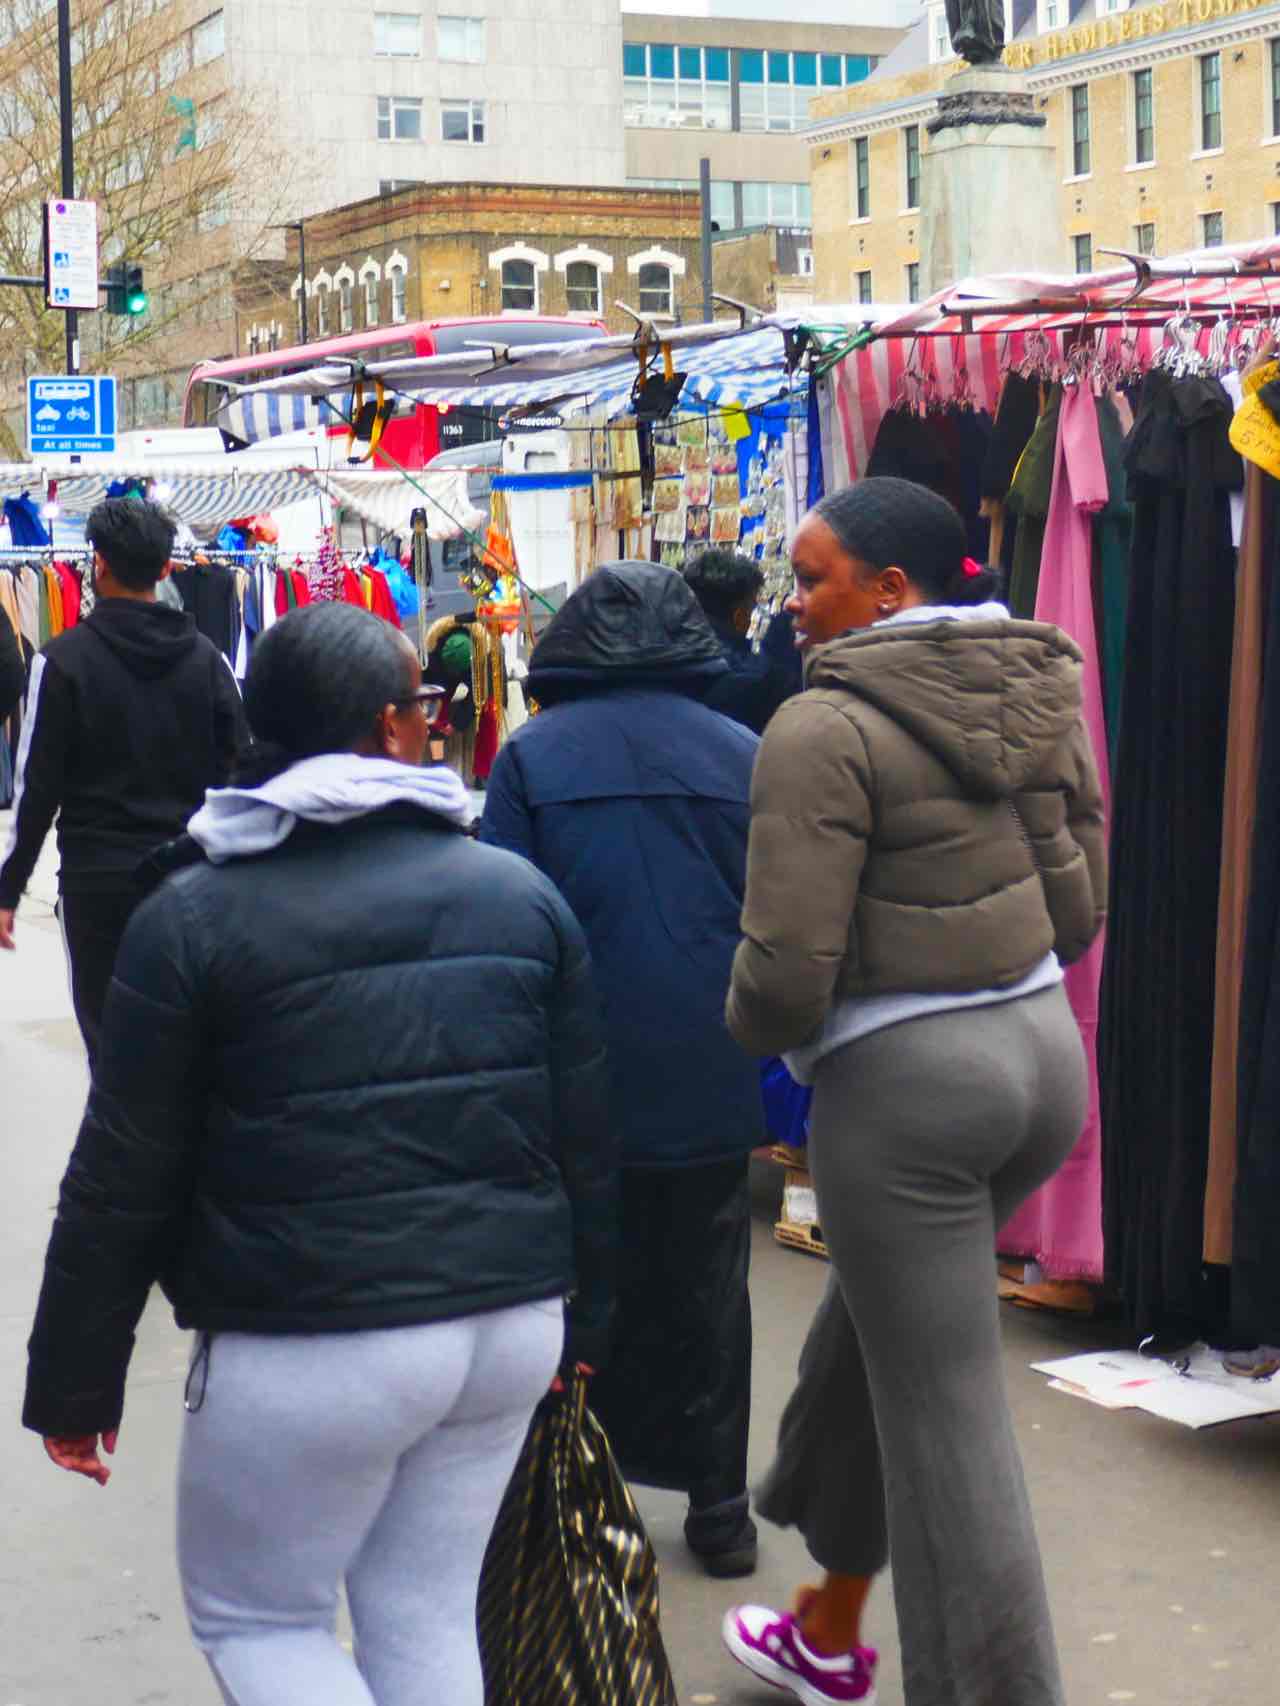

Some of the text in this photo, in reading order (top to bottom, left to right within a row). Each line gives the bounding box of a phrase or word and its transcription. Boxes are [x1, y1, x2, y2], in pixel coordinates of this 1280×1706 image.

[1046, 7, 1166, 58] HAMLETS
[36, 424, 56, 432] taxi
[43, 440, 102, 449] At all times
